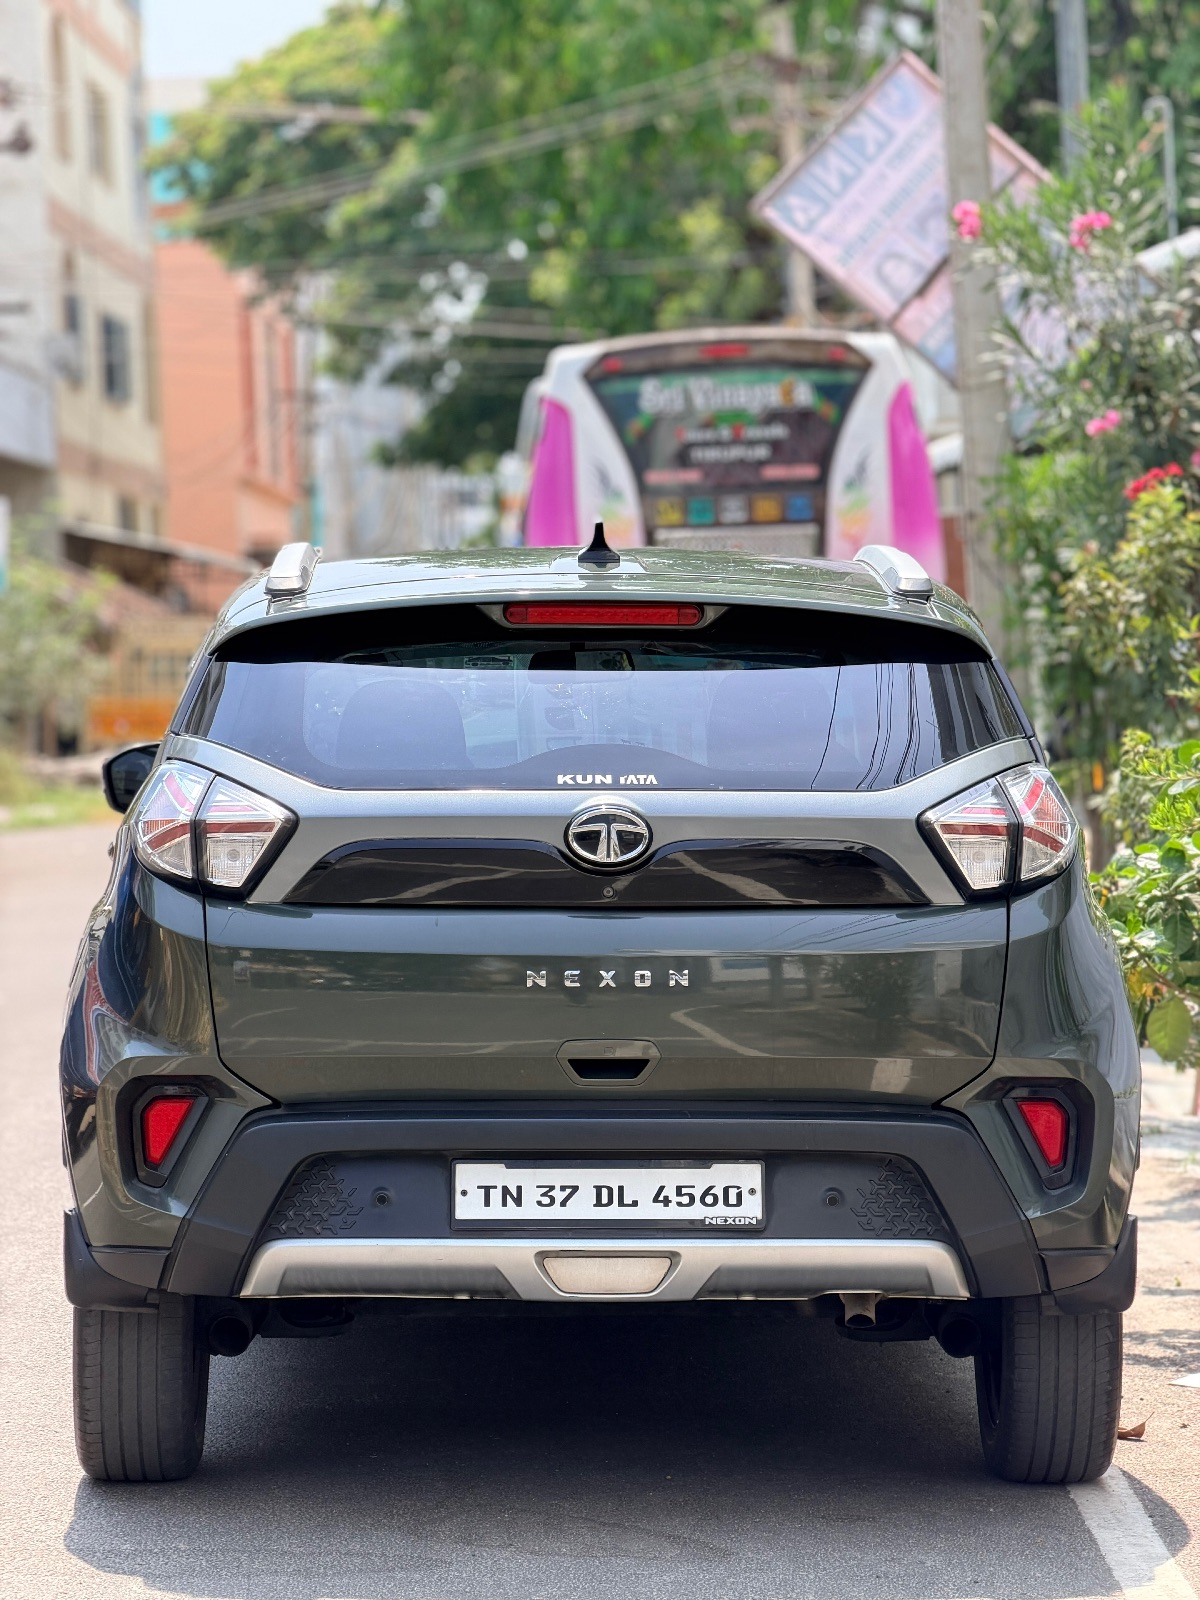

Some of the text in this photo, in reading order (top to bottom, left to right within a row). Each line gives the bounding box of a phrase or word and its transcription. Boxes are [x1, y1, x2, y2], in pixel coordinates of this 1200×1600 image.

[557, 774, 613, 785] KUN
[526, 969, 689, 988] NEXON
[476, 1184, 743, 1208] TN 37 DL 4560
[704, 1216, 758, 1226] NEXON
